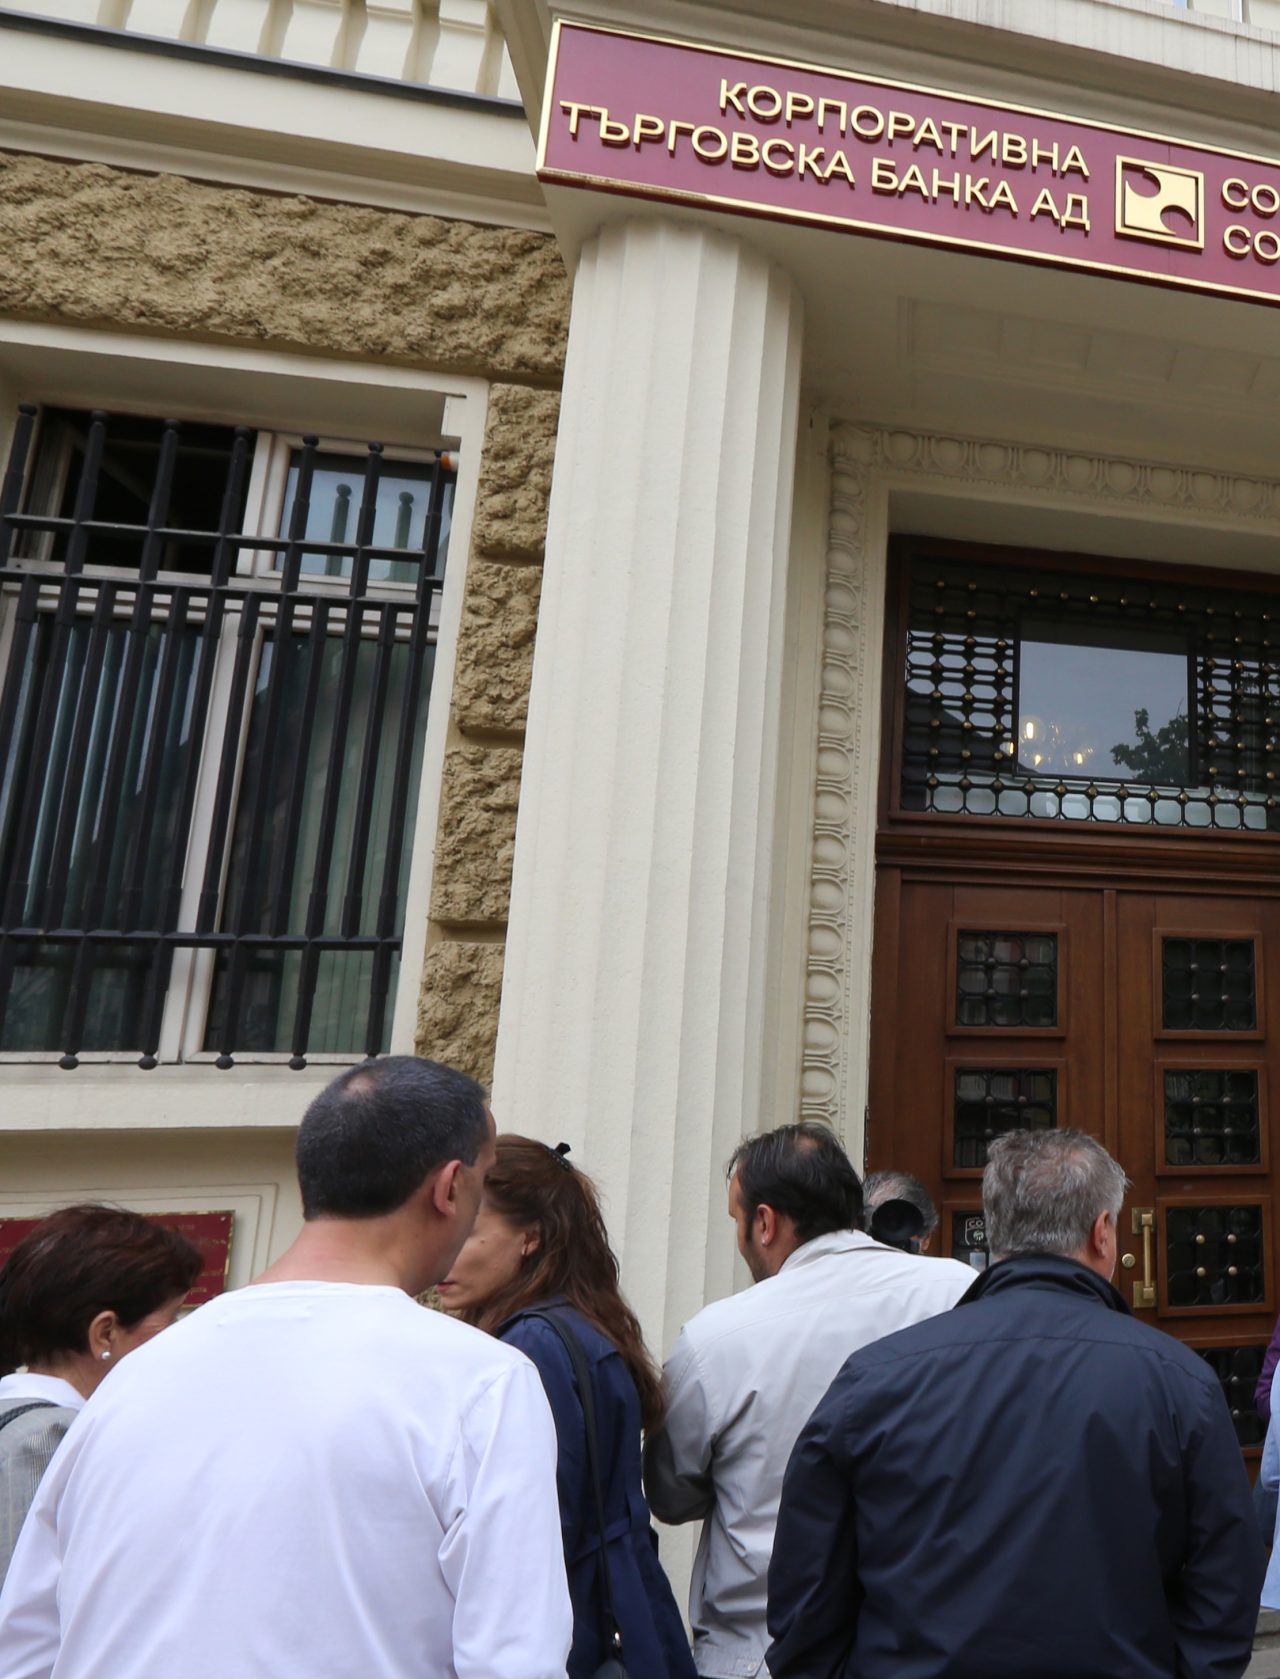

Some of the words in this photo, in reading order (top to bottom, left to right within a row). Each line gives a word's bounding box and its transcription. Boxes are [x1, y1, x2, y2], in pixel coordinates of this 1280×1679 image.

[559, 100, 855, 184] ТЪРГОВСКА
[871, 157, 1019, 214] БАНКА
[1030, 188, 1091, 232] АД
[719, 78, 1091, 178] КОРПОРАТИВНА
